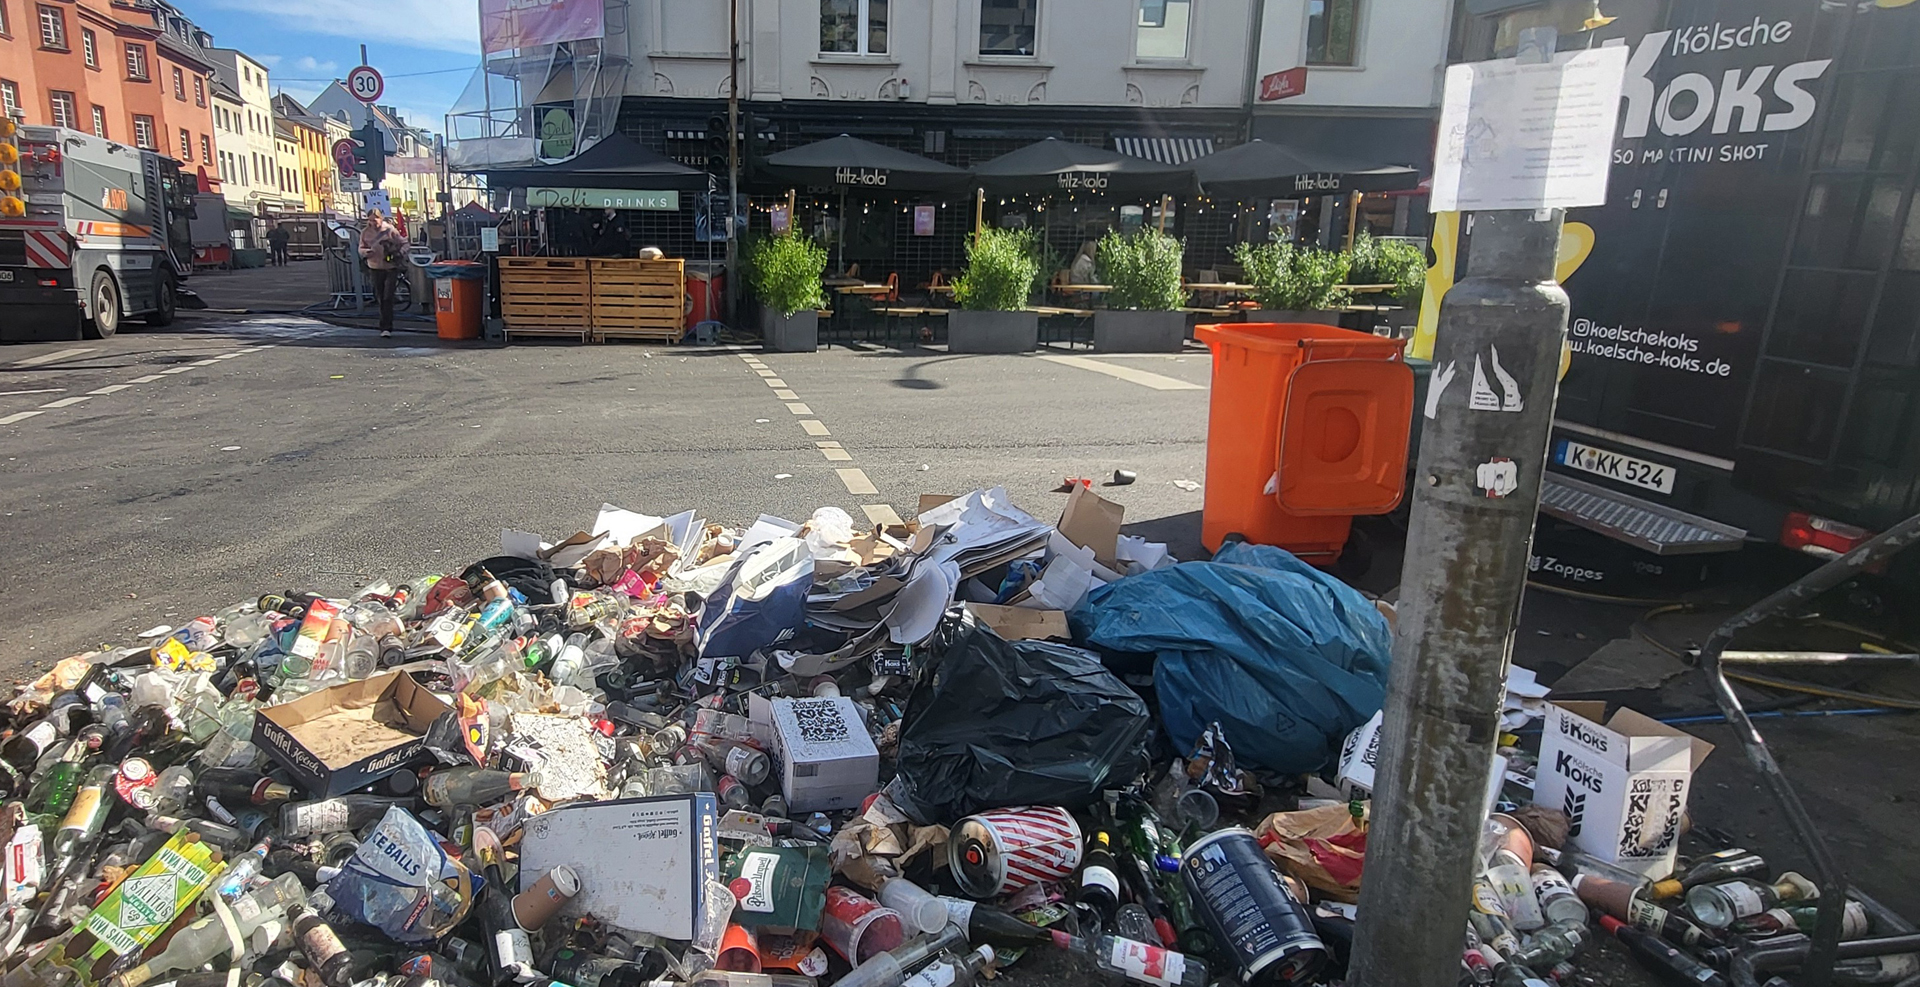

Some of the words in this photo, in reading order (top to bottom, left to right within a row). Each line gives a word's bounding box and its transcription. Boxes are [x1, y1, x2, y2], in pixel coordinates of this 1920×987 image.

[1671, 16, 1792, 57] Kölsche
[355, 76, 376, 93] 30
[1719, 144, 1769, 163] SHOT
[836, 166, 887, 187] fritz-kola
[1057, 172, 1108, 189] fritz-kola
[1294, 173, 1341, 191] fritz-kola
[535, 188, 592, 208] Deli
[603, 198, 669, 209] DRINKS
[1590, 321, 1699, 352] koelschekoks
[1572, 446, 1587, 467] K
[1595, 452, 1623, 477] KK
[1625, 460, 1665, 489] 524
[1542, 556, 1604, 581] Zappes
[263, 723, 292, 755] Gaffel
[1570, 722, 1608, 753] KOKS
[367, 750, 403, 774] Gaffel
[1555, 749, 1603, 794] KOKS
[1571, 756, 1604, 780] Kölsche
[372, 831, 387, 849] CE
[383, 847, 421, 877] BALLS
[703, 814, 716, 866] Gaffel
[160, 848, 178, 870] VIVA
[185, 864, 206, 885] VIDA
[130, 880, 172, 918] SALITOS
[747, 877, 766, 907] Pilsner
[89, 915, 107, 936] VIVA
